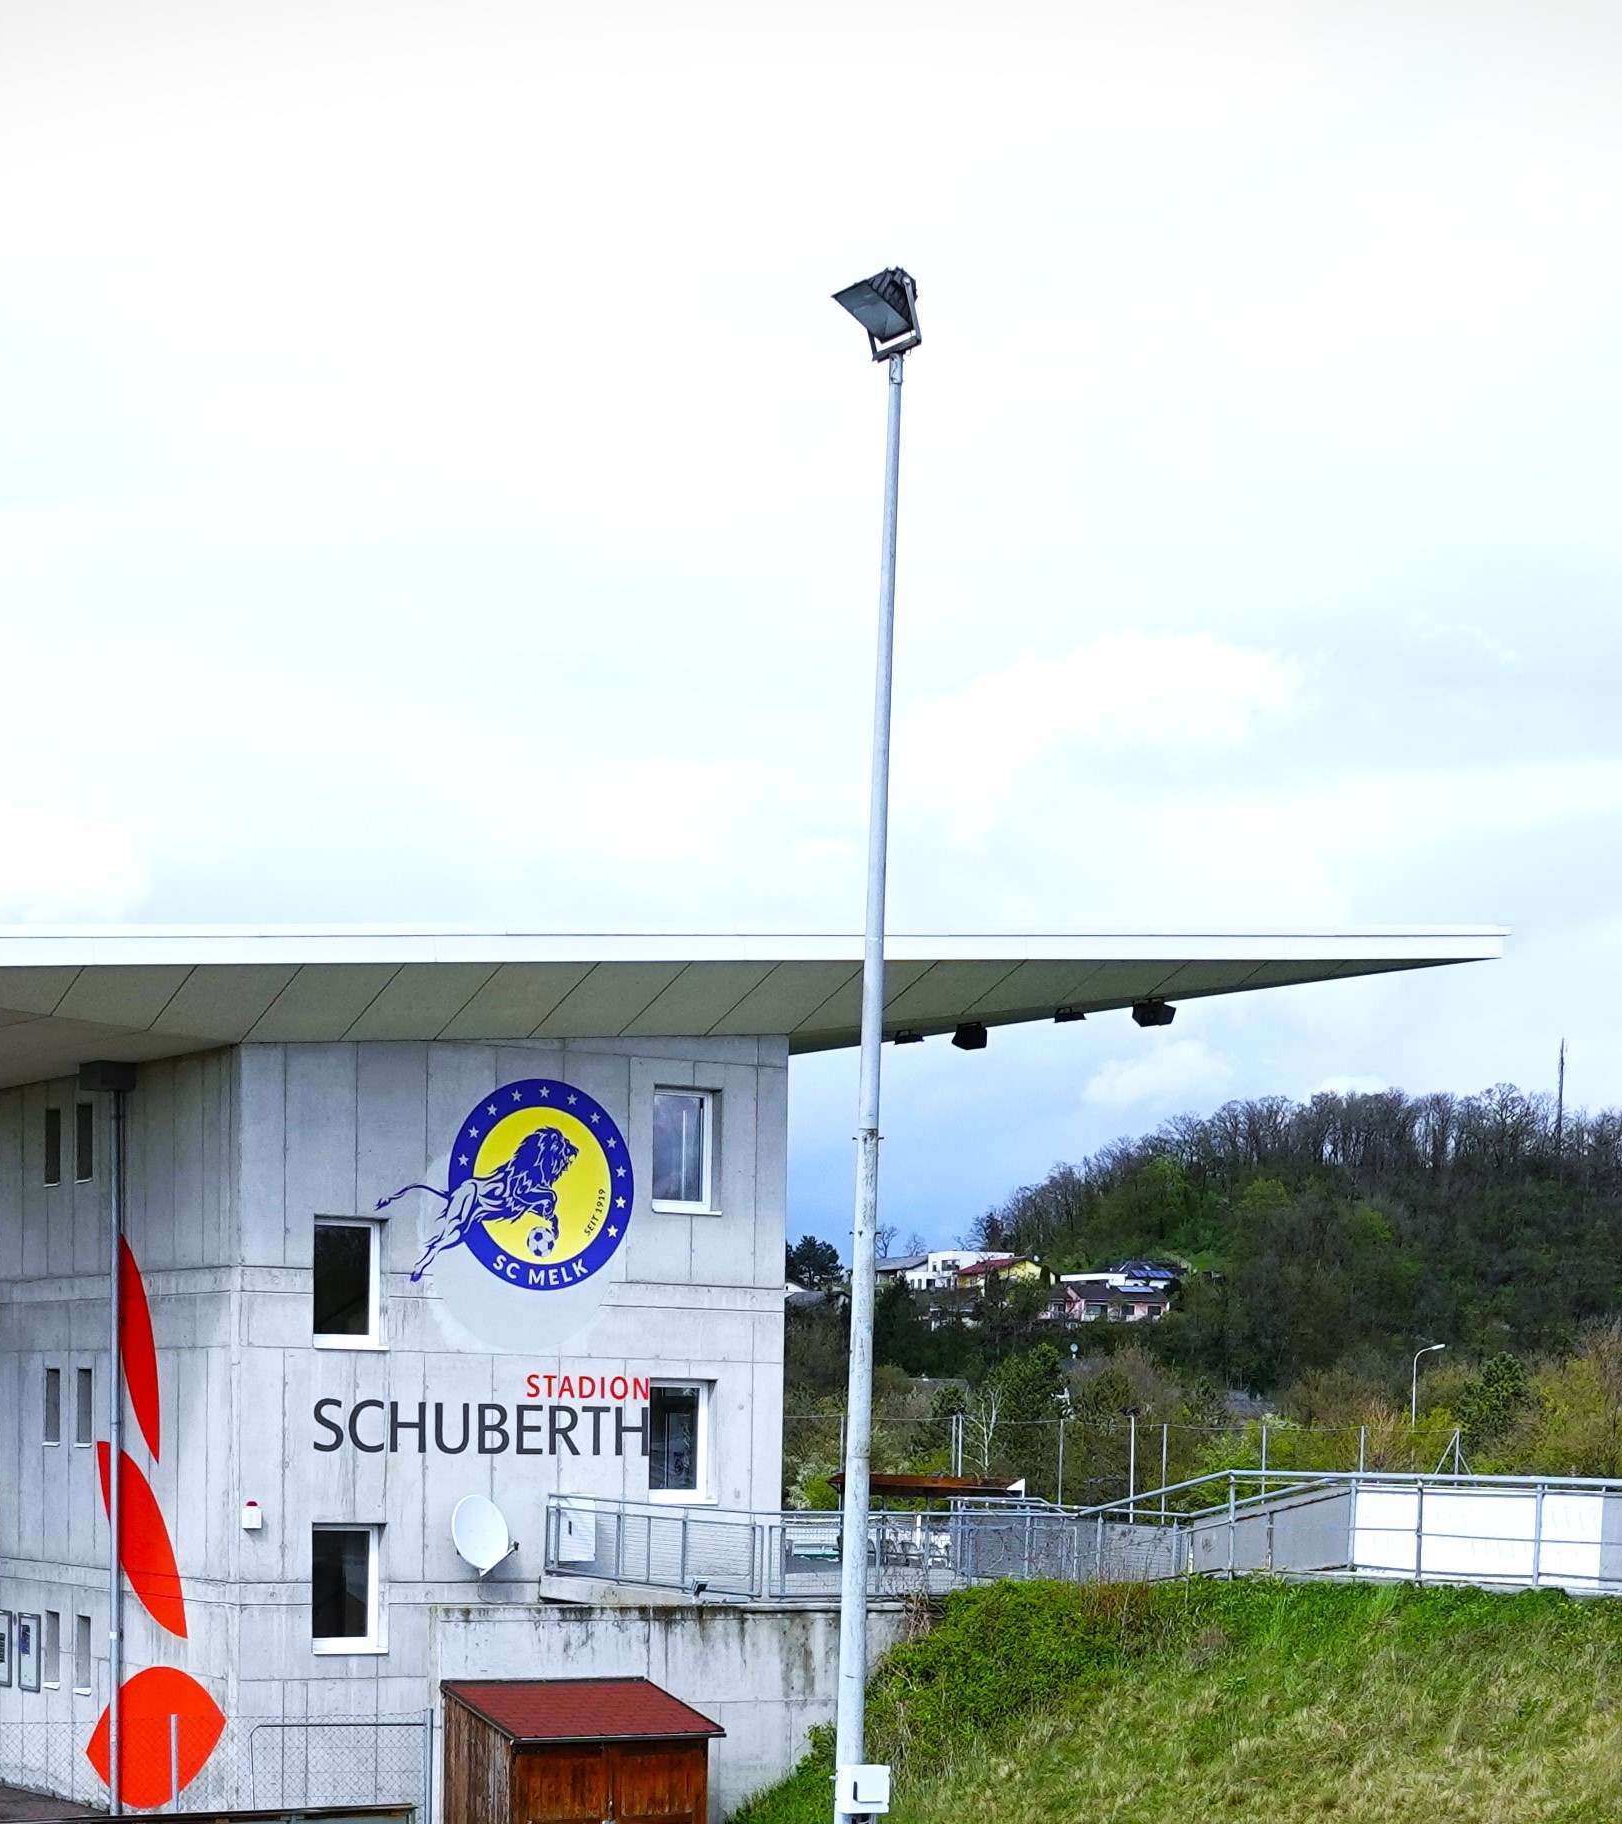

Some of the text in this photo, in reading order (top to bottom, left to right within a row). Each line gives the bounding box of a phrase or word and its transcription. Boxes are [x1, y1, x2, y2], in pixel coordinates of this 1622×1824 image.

[583, 1188, 607, 1237] SEIT 1919
[492, 1253, 590, 1287] SC MELK
[525, 1373, 650, 1402] STADION
[312, 1397, 650, 1457] SCHUBERTH
